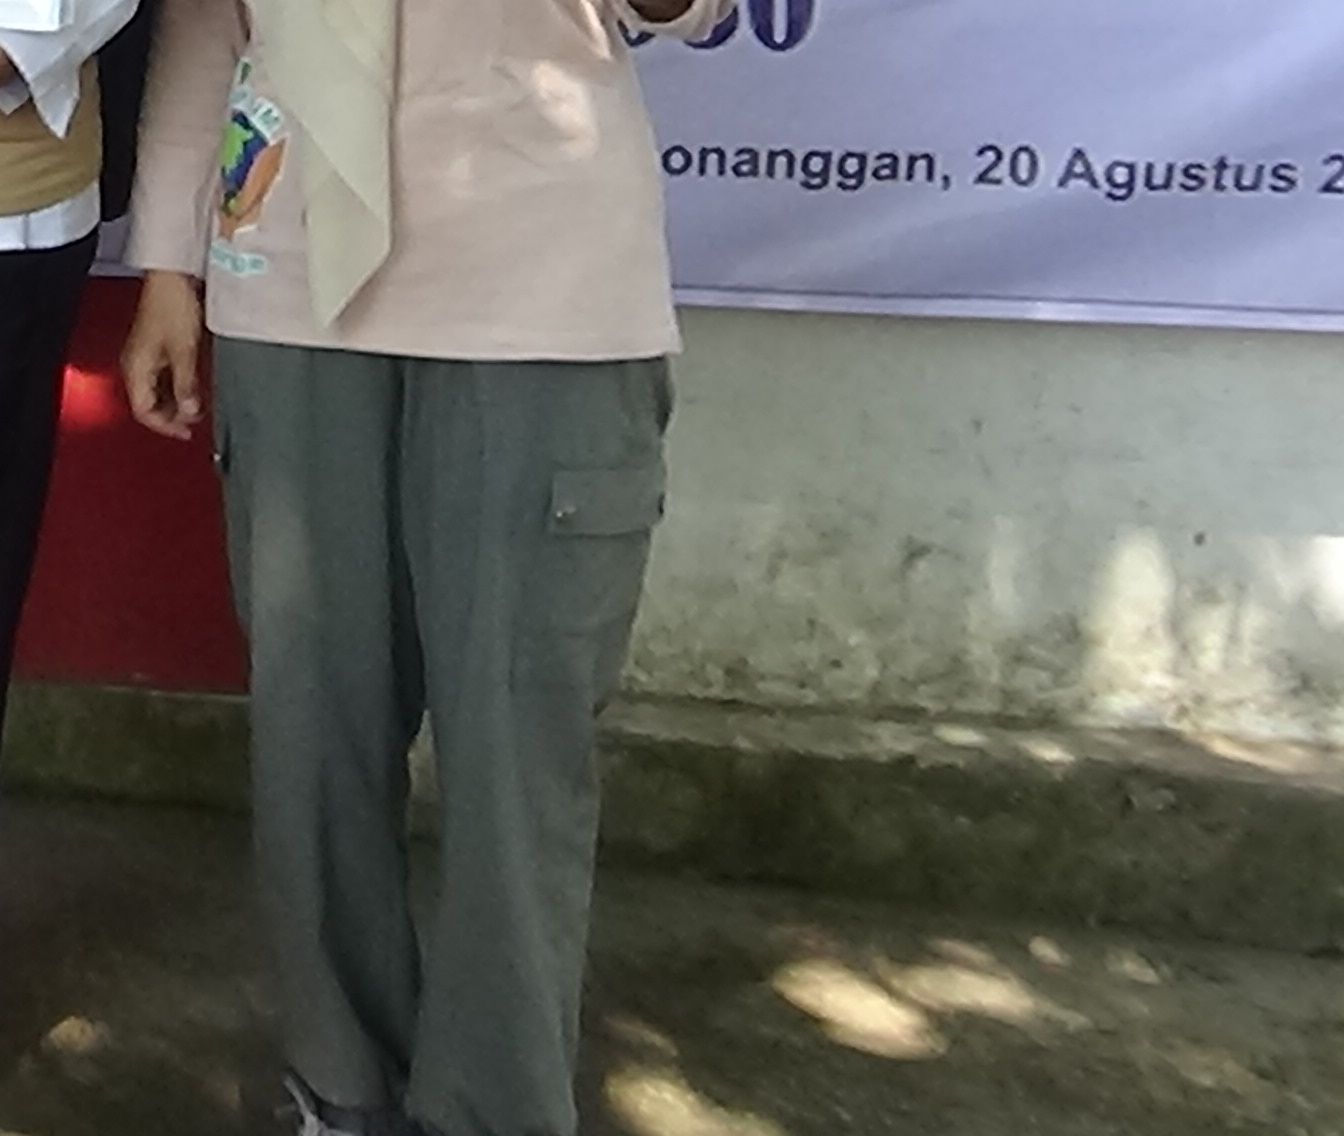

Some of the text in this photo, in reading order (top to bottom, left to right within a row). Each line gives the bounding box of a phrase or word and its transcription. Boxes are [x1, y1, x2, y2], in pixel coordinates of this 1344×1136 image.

[659, 145, 952, 191] onanggan,
[972, 145, 1040, 187] 20
[1057, 147, 1298, 202] Agustus
